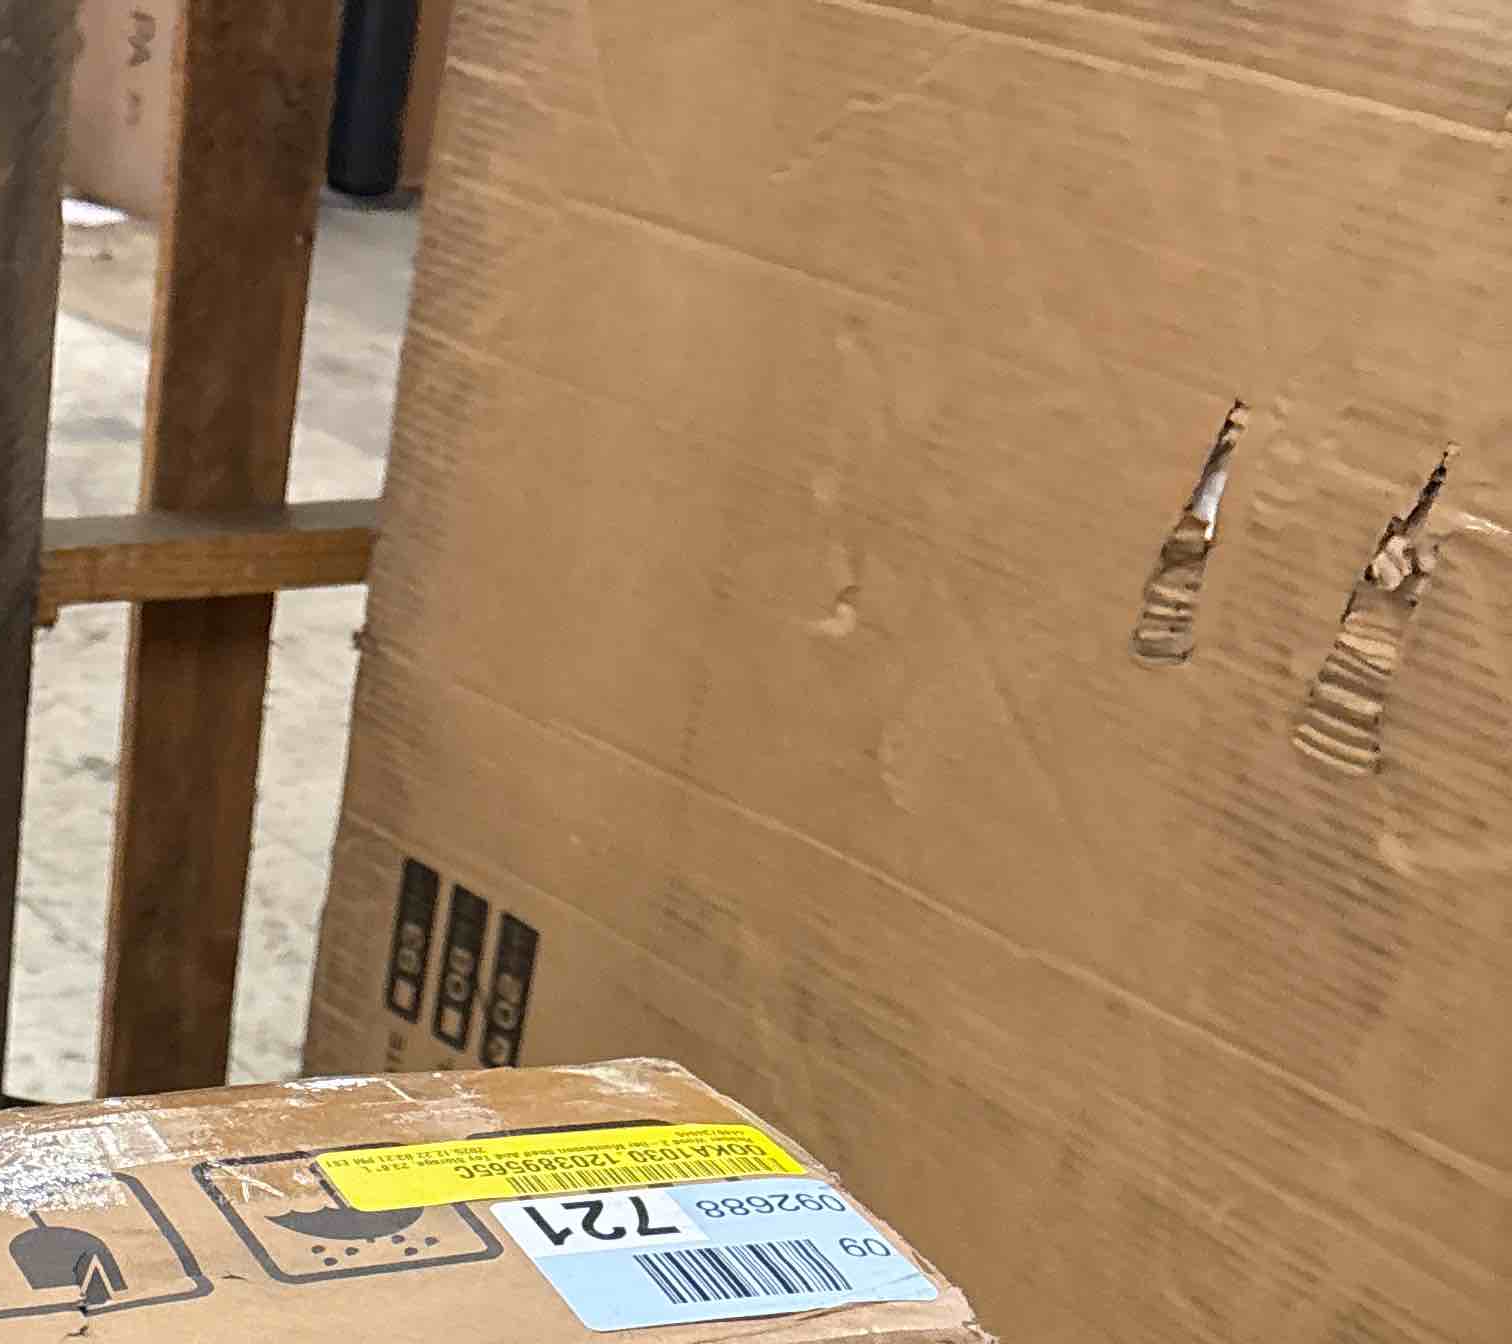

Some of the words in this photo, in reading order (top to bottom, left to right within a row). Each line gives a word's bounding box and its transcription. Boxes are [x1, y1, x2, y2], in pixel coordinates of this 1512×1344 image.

[696, 1193, 847, 1219] 092688
[522, 1195, 682, 1246] 721
[838, 1237, 891, 1257] 09
